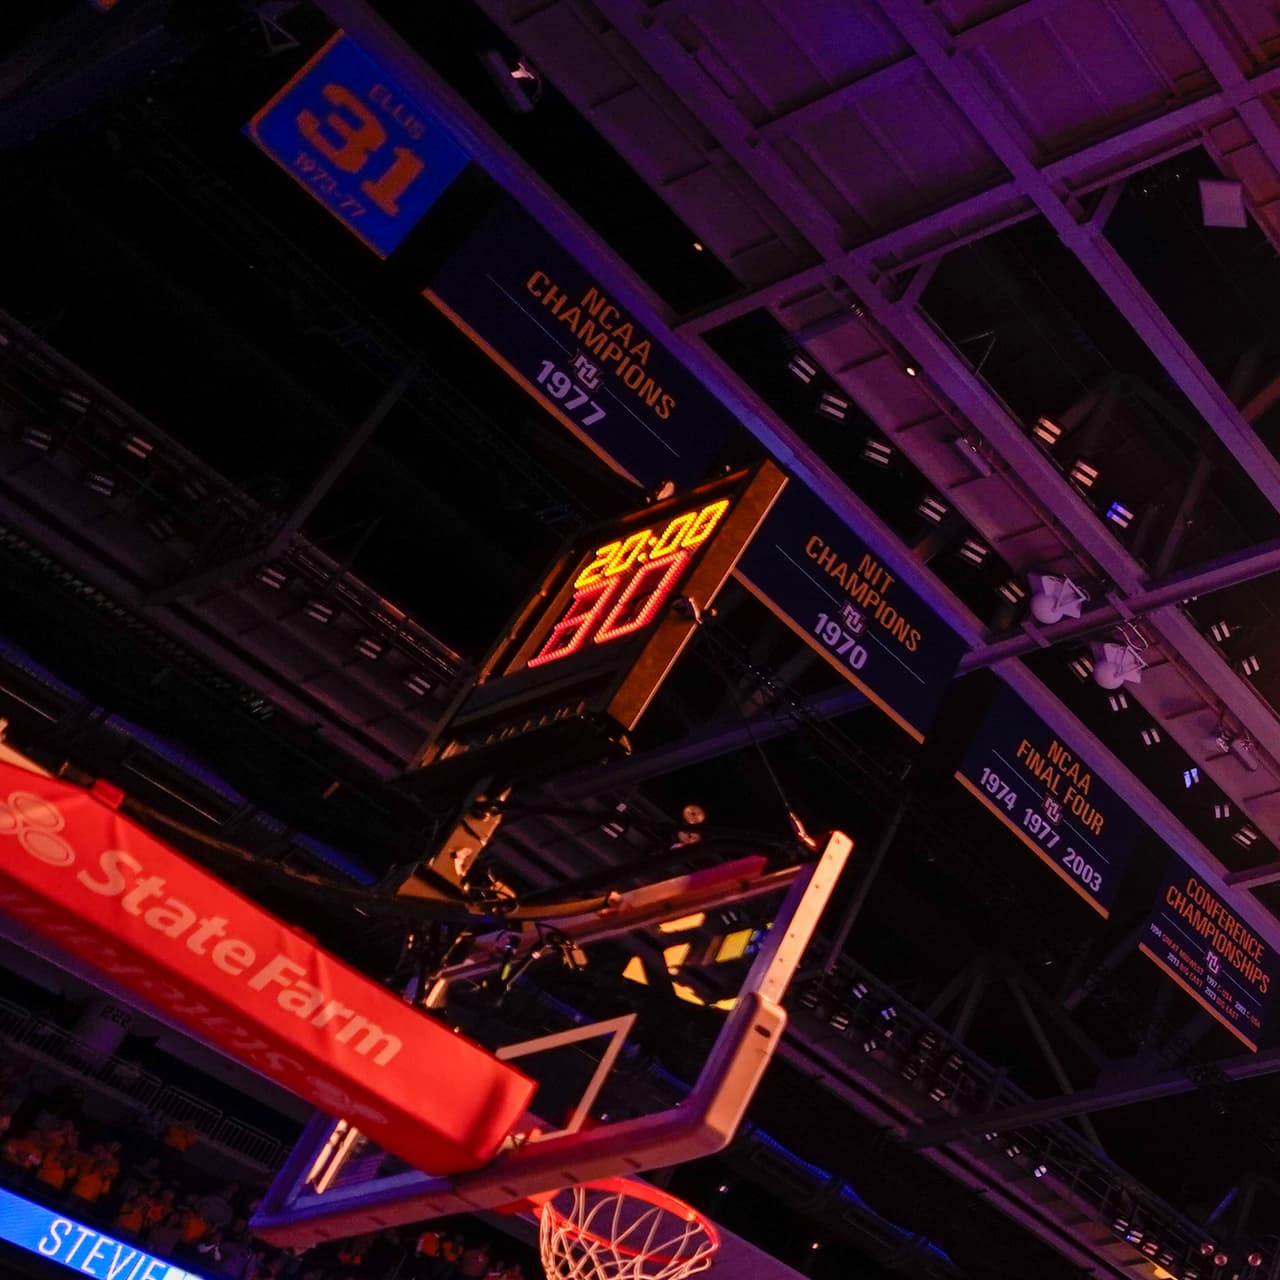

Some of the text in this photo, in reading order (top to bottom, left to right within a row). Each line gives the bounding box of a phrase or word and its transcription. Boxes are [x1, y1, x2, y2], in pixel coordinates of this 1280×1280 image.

[297, 83, 425, 217] 31
[526, 270, 676, 420] CHAMPIONS
[580, 287, 652, 367] NCAA
[536, 360, 606, 427] 1977
[573, 500, 729, 588] 20:00
[858, 553, 896, 594] NIT
[528, 548, 688, 669] 30
[805, 535, 921, 652] CHAMPIONS
[814, 612, 868, 670] 1970
[1016, 739, 1104, 836] FINAL FOUR
[1047, 740, 1091, 795] NCAA
[980, 767, 1103, 892] 1974 1977 2003
[1165, 885, 1270, 995] CHAMPIONSHIPS
[1185, 877, 1265, 965] CONFERENCE
